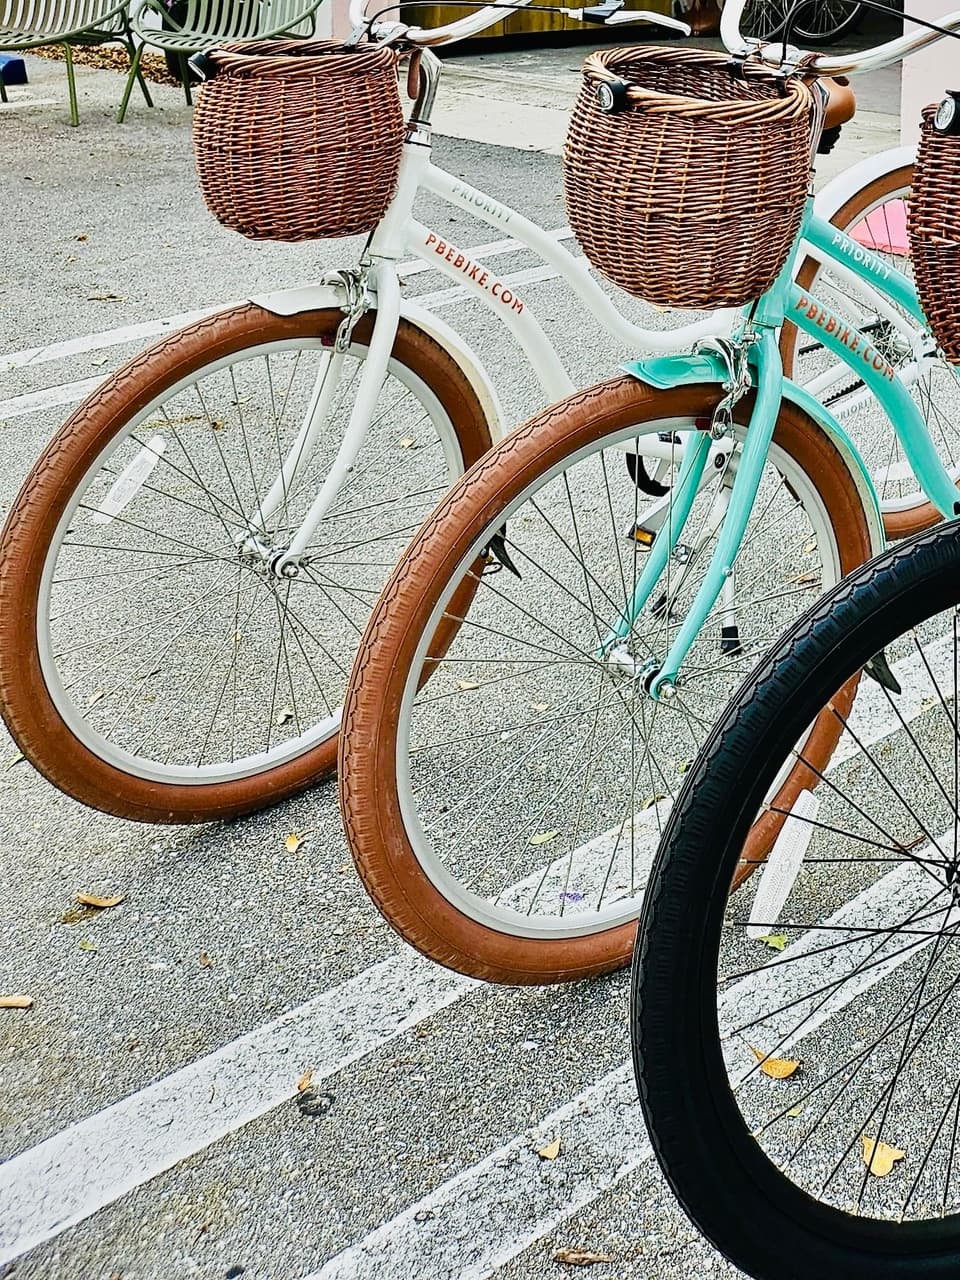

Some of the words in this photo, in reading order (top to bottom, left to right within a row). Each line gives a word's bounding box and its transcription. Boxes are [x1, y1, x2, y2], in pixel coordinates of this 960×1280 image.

[452, 184, 513, 223] PRIORITY
[425, 233, 525, 314] PBEBIKE.COM
[832, 233, 891, 280] PRIORITY
[795, 296, 895, 382] PBEBIKE.COM
